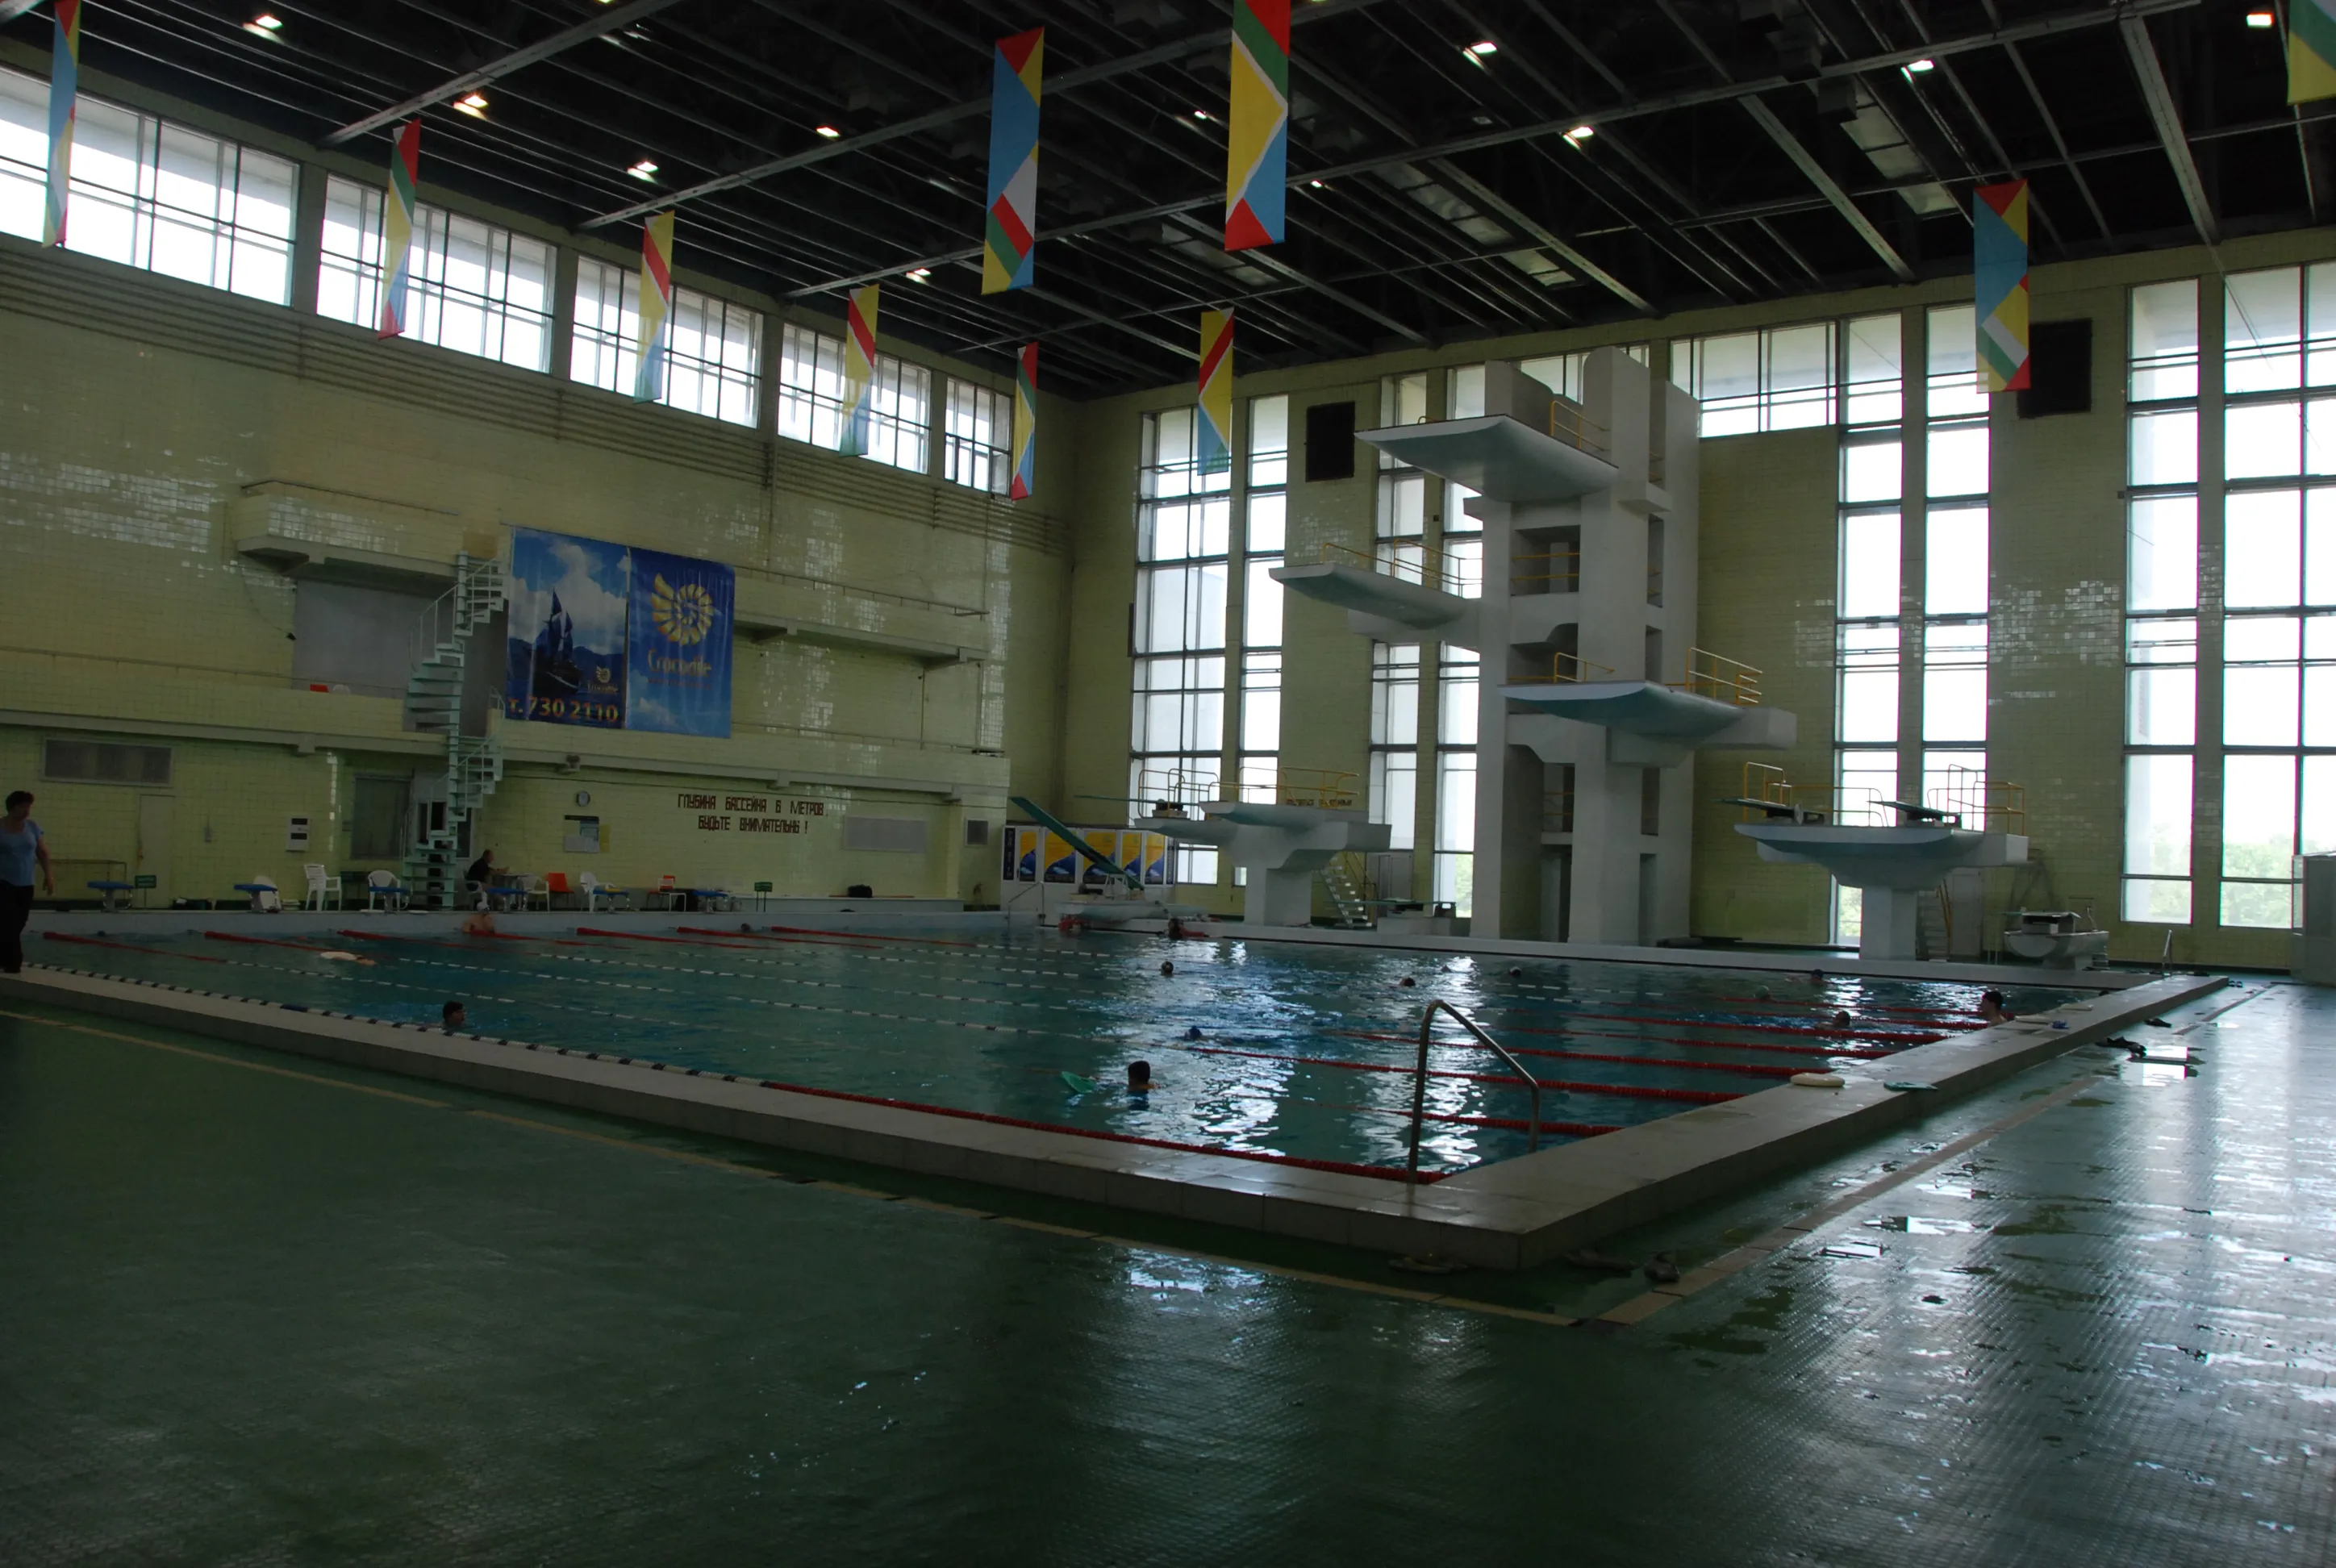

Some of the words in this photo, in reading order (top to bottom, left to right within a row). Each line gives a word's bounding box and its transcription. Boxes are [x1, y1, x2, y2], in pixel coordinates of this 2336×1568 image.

[648, 648, 712, 677] Crocodile
[528, 694, 565, 718] 730
[569, 699, 619, 723] 2110
[678, 794, 716, 810] ГЛУБИНА
[725, 795, 767, 813] БАССЕЙНА
[698, 815, 731, 831] БУДЬТЕ
